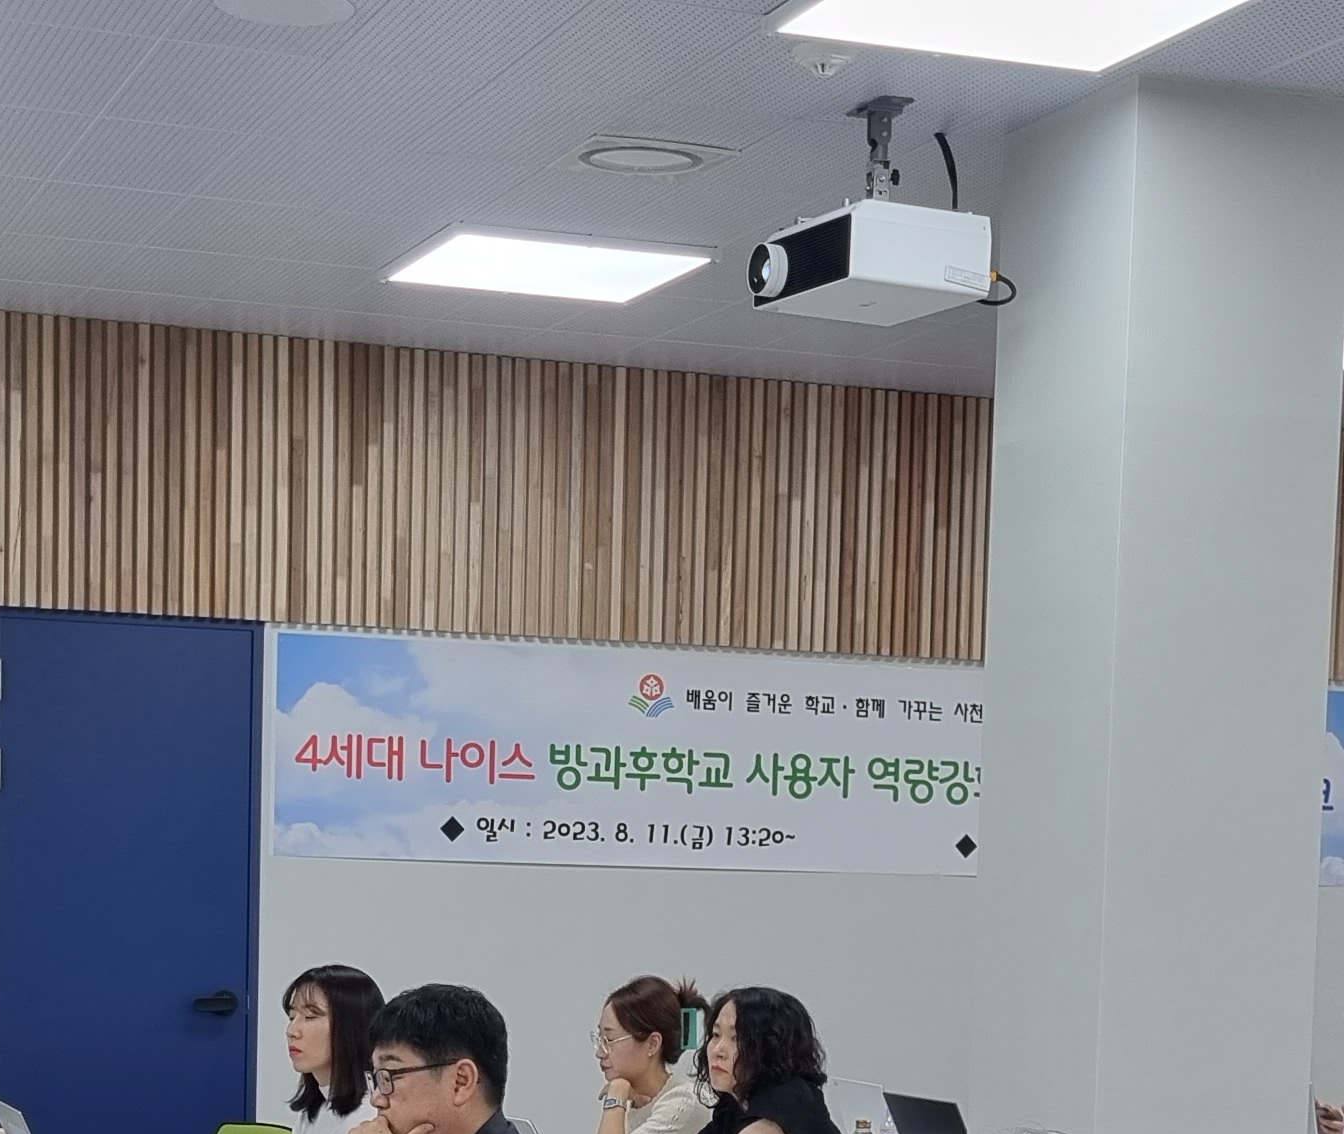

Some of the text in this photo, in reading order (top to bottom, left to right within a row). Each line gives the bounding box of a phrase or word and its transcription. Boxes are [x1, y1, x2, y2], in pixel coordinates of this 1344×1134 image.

[686, 688, 733, 711] 배움이
[745, 692, 793, 715] 즐거운
[898, 700, 943, 722] 가꾸는
[954, 702, 983, 724] 사천
[294, 733, 405, 781] 4세대
[419, 737, 536, 785] 나이스
[549, 743, 734, 795] 방과후학교
[745, 752, 856, 800] 사용자
[476, 816, 516, 843] 일시
[542, 820, 606, 842] 2023.
[614, 822, 635, 844] 8.
